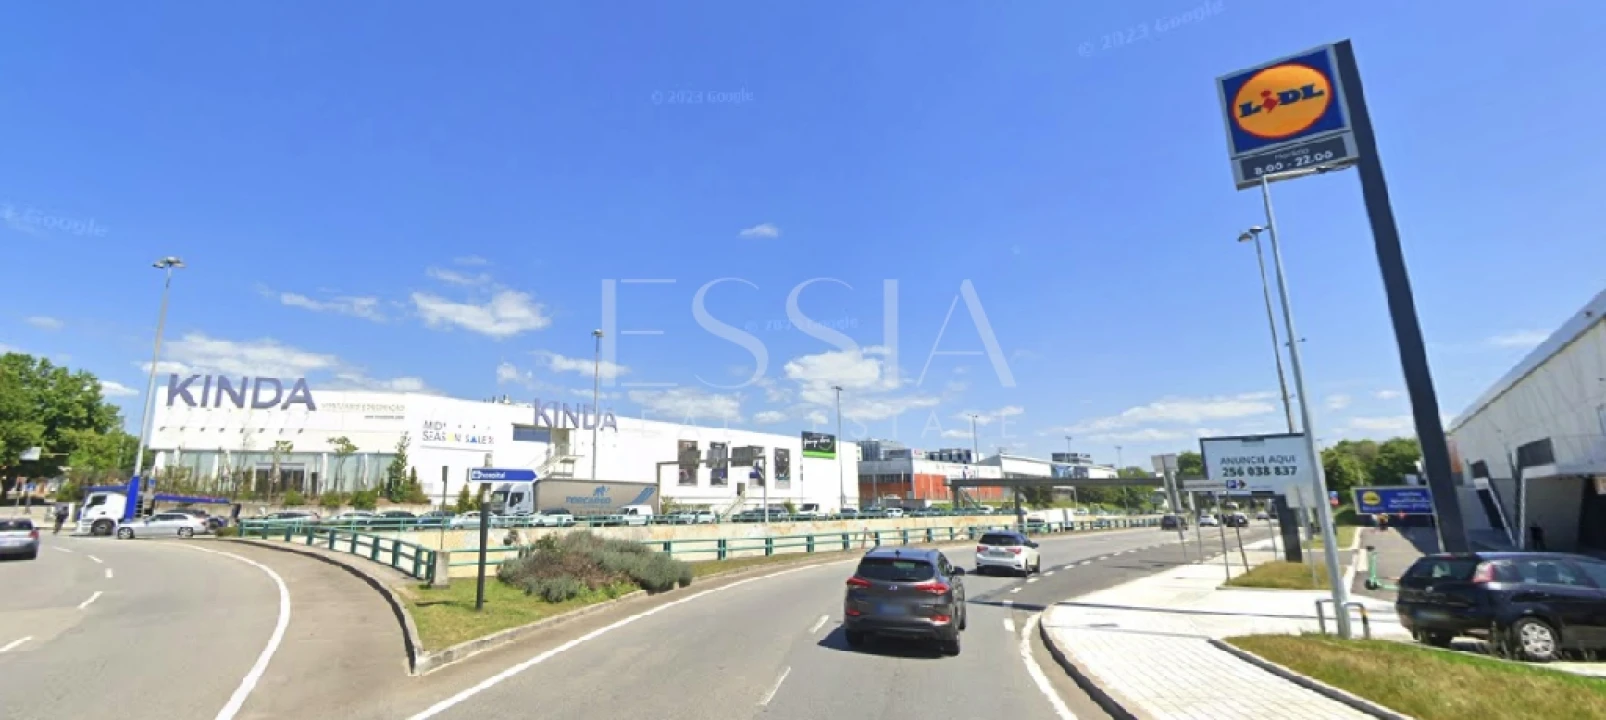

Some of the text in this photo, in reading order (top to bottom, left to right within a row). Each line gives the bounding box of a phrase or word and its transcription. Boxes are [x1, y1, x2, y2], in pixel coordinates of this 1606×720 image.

[1238, 83, 1325, 118] LIDL
[166, 373, 317, 412] KINDA
[533, 398, 618, 434] KINDA
[1222, 466, 1245, 477] 256
[1268, 454, 1297, 464] AQUI
